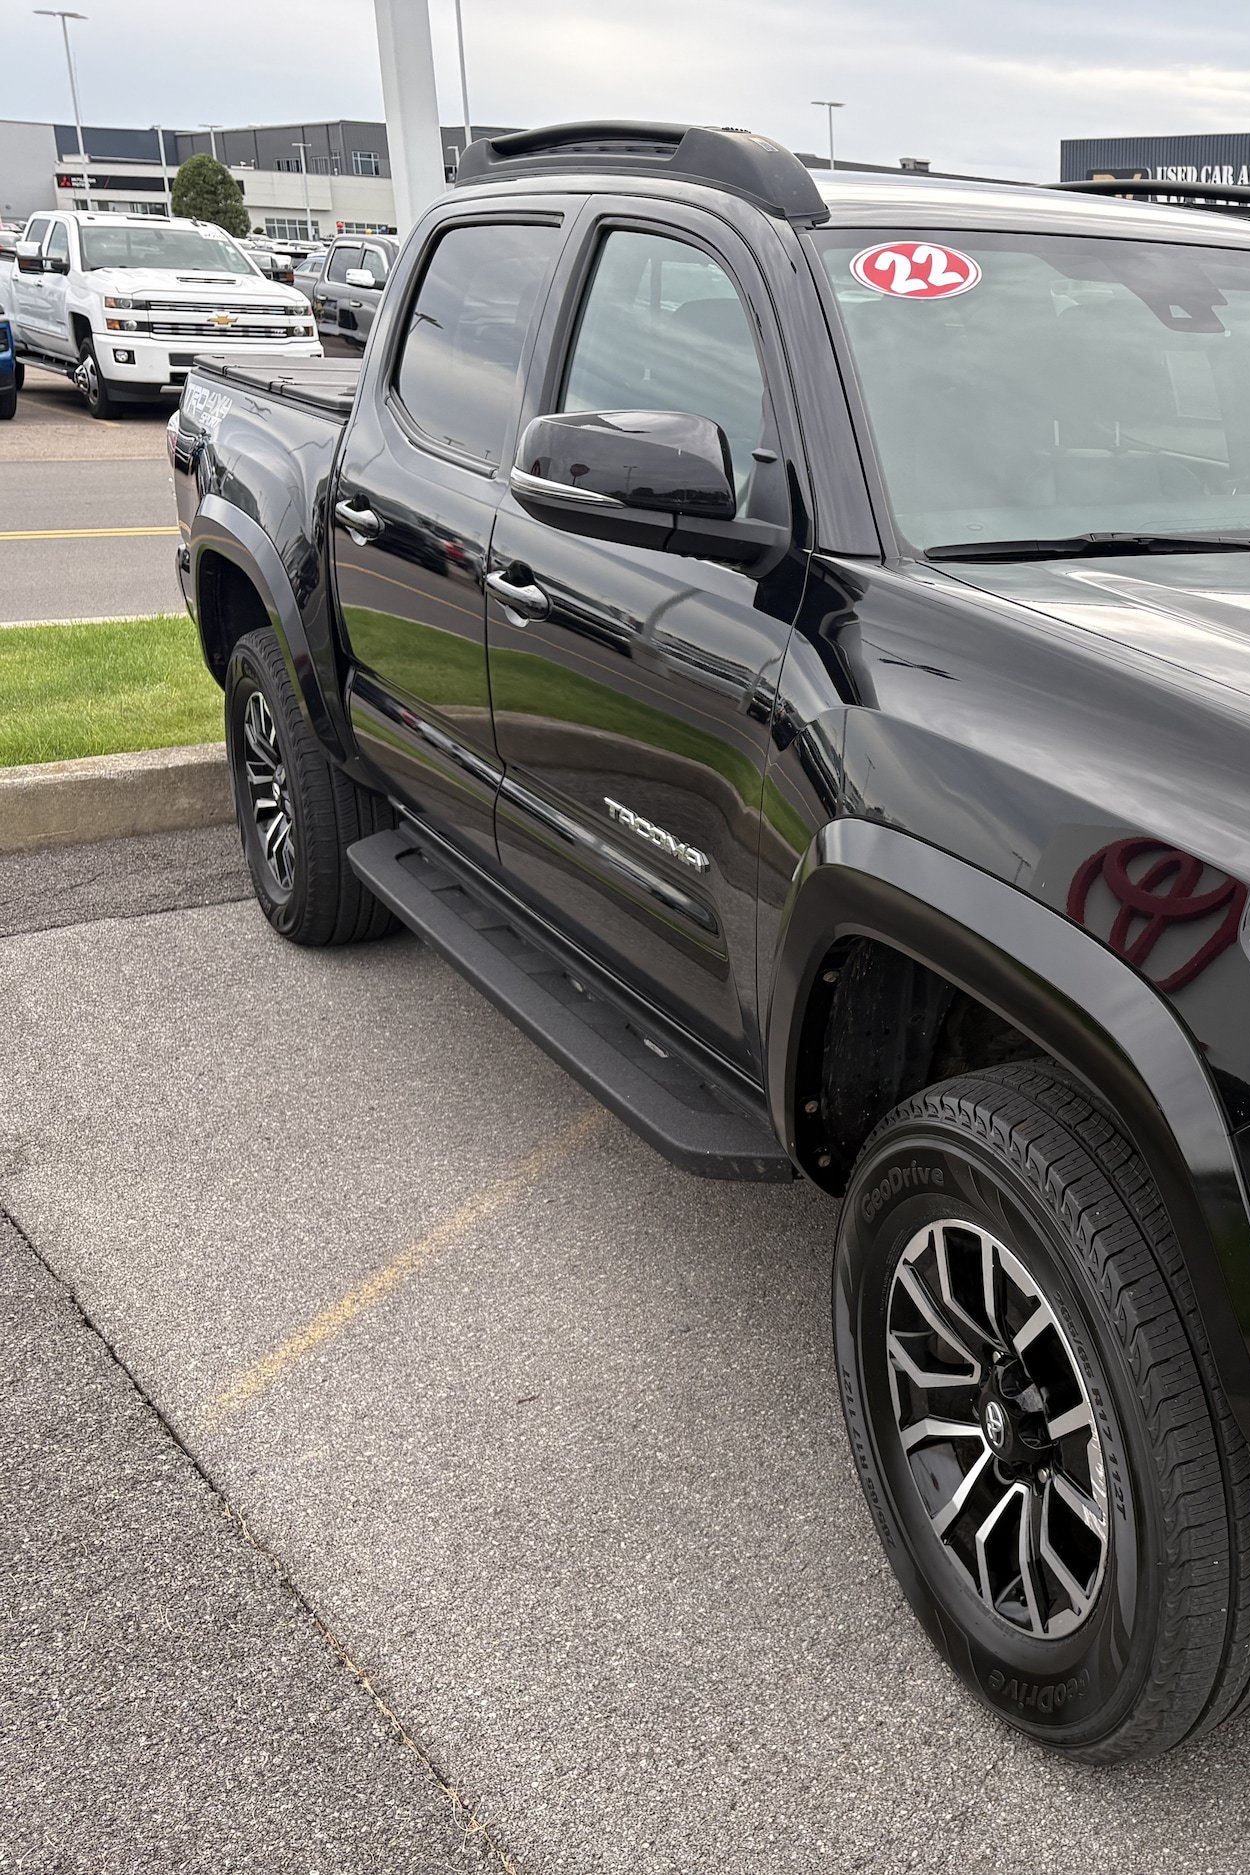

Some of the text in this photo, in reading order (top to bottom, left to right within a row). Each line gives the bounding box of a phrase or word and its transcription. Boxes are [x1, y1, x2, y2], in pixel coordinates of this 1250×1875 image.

[1156, 166, 1198, 183] USED
[1200, 165, 1234, 185] CAR
[874, 245, 965, 294] 22
[184, 383, 210, 418] TRD
[199, 411, 222, 428] SPORT
[604, 797, 710, 873] TACOMA
[861, 1160, 944, 1224] GeoDrive
[1092, 1387, 1113, 1442] R17
[1109, 1453, 1126, 1520] 112T
